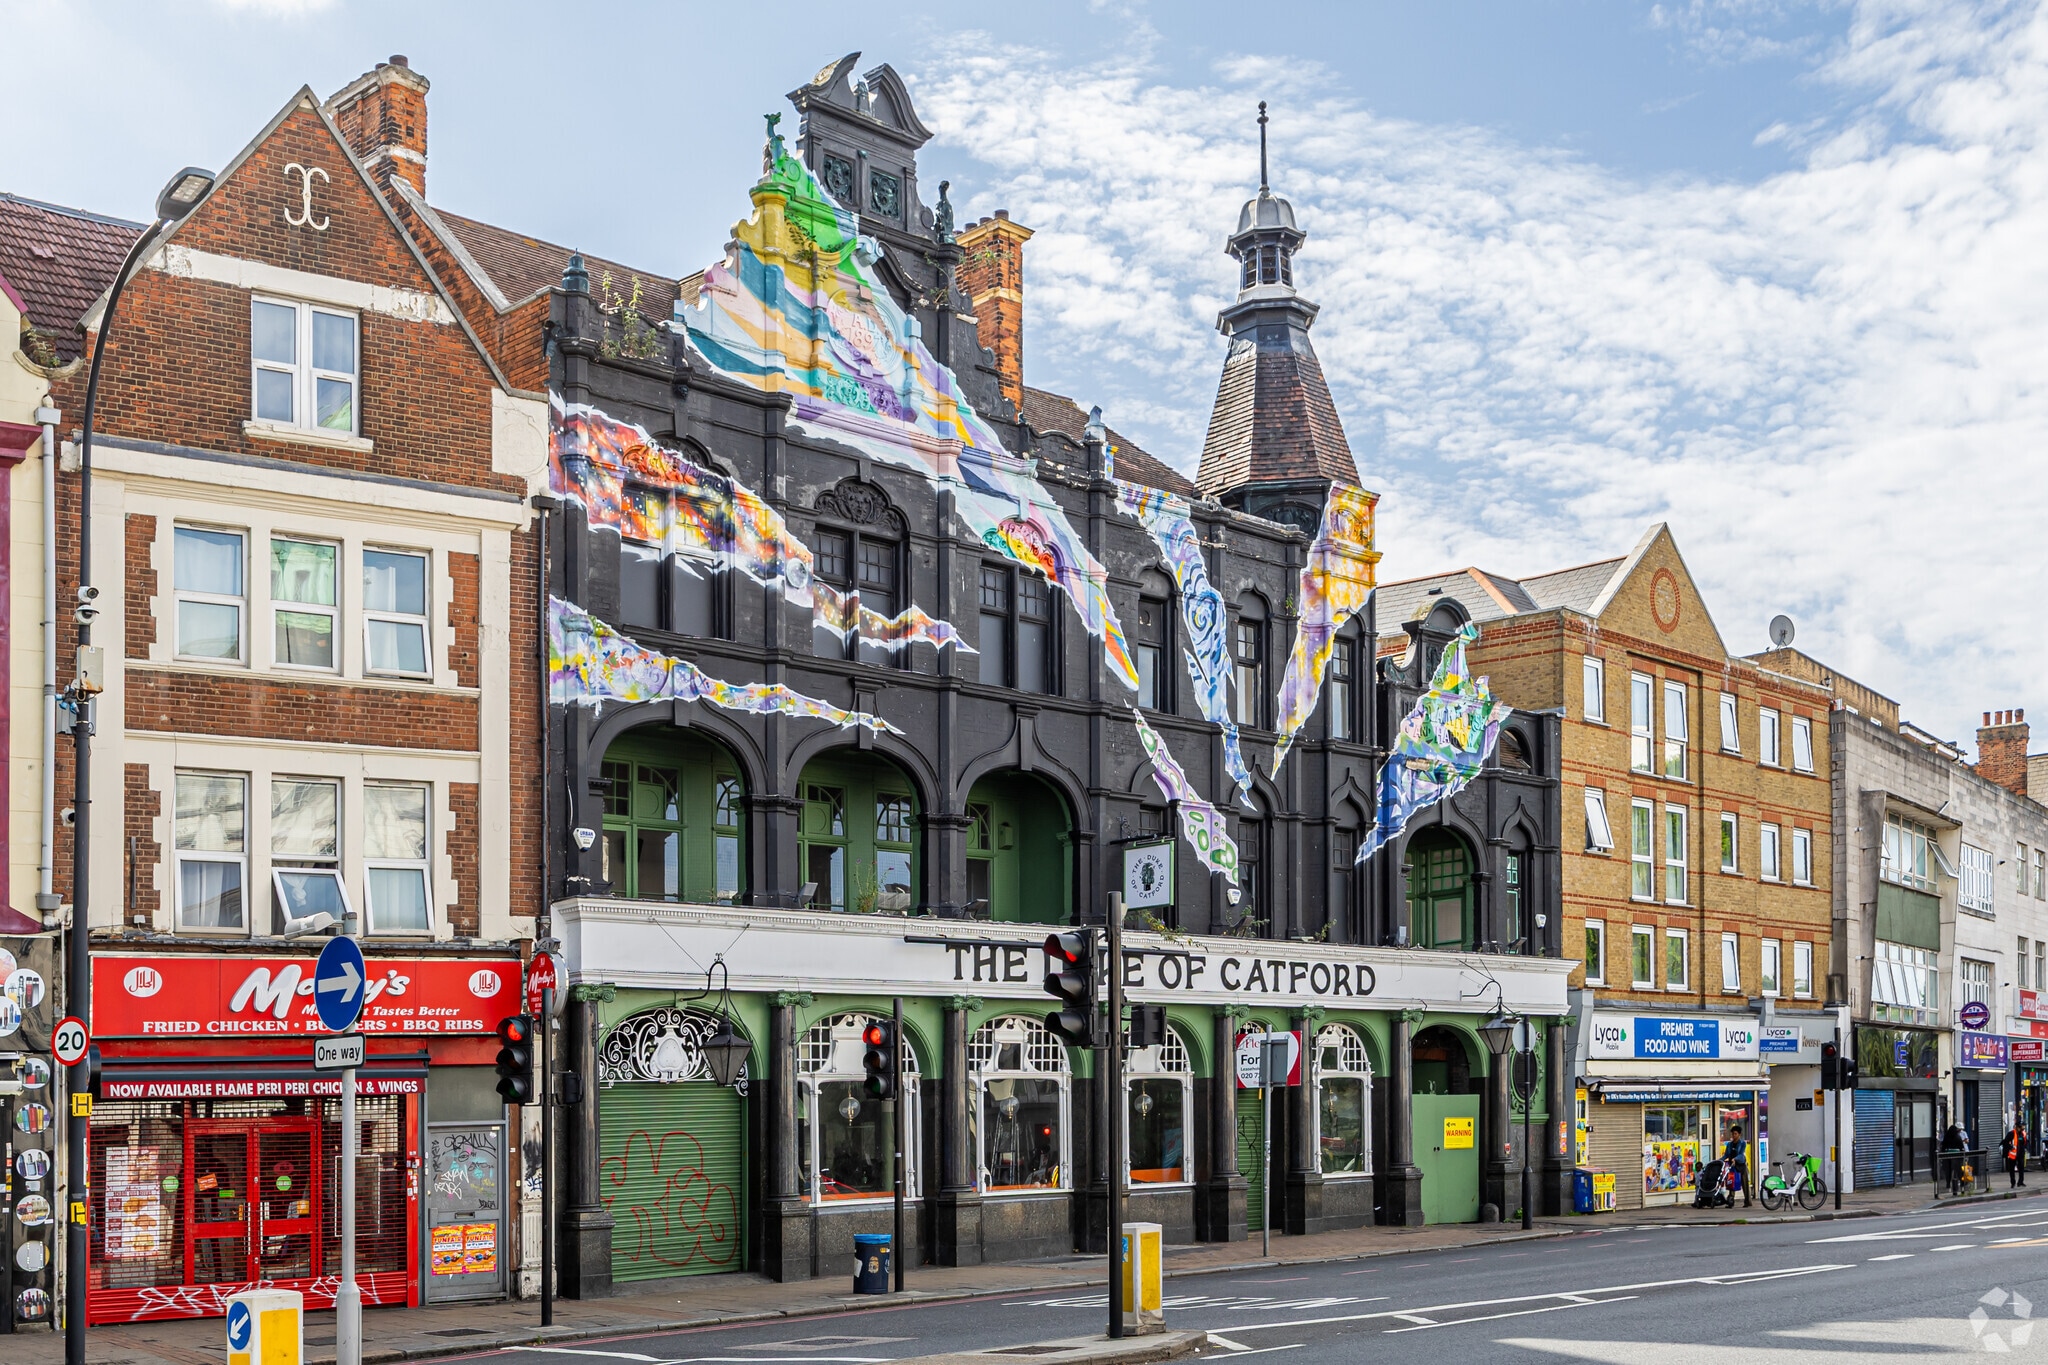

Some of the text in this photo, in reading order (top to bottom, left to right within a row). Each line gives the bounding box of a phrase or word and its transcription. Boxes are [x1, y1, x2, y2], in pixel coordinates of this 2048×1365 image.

[1131, 854, 1164, 874] THE DUKE
[1131, 875, 1165, 899] OF CATFORD
[945, 943, 1029, 982] THE
[1158, 955, 1207, 990] OF
[1220, 957, 1376, 997] CATFORD
[229, 963, 411, 1020] Moy's
[373, 1006, 414, 1016] Tastes
[418, 1006, 460, 1016] Better
[142, 1019, 484, 1033] FRIED CHICKEN BUERS BBQ RIBS
[1595, 1023, 1619, 1045] Lyca
[1660, 1022, 1694, 1036] PREMIER
[1766, 1028, 1786, 1037] Lyca
[58, 1031, 84, 1051] 20
[1725, 1027, 1746, 1046] Lyca
[317, 1046, 360, 1061] One way
[1644, 1039, 1710, 1054] FOOD AND WINE
[1240, 1055, 1260, 1065] For
[110, 1080, 418, 1097] NOW AVAILABLE FLAME PERI PERI CHICN & WINGS
[1446, 1129, 1472, 1137] WARNING
